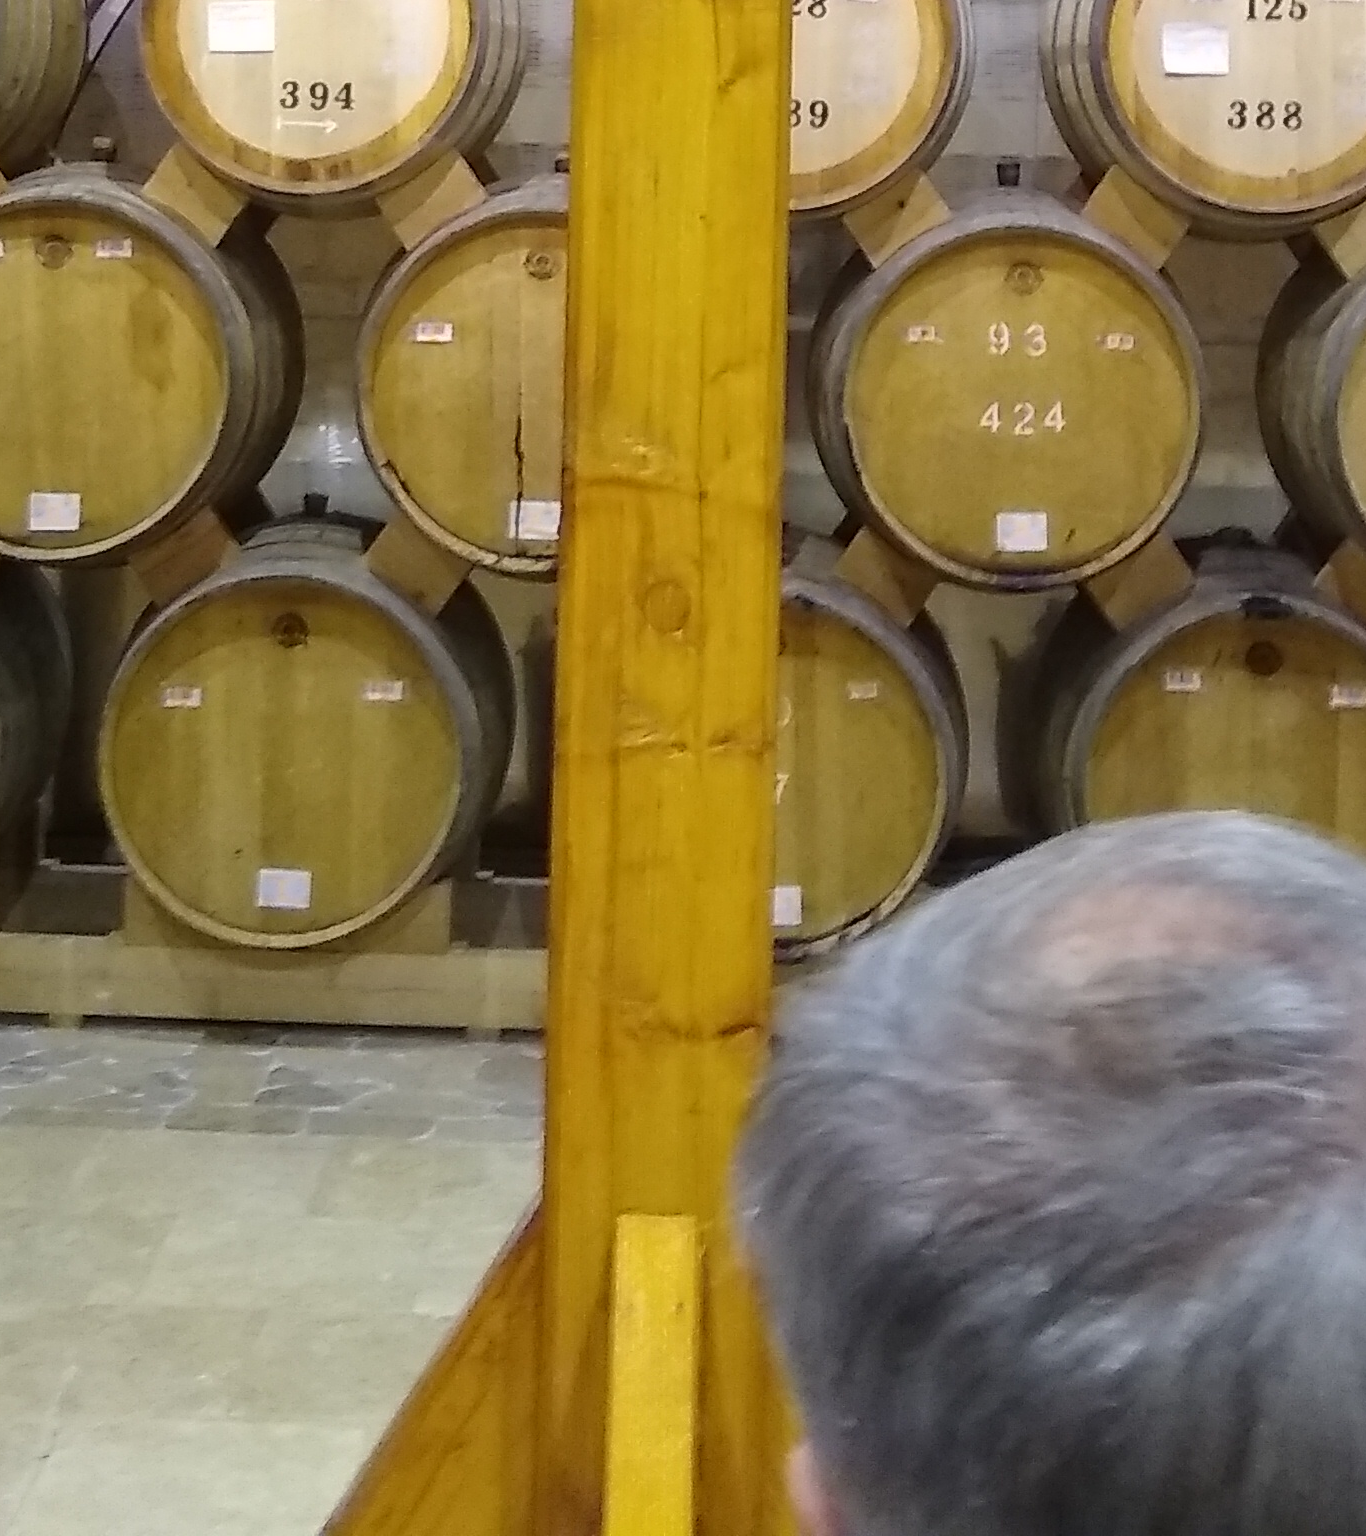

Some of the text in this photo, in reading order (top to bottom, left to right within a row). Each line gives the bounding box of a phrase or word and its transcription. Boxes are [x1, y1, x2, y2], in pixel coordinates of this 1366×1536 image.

[280, 81, 355, 111] 394
[1227, 100, 1304, 131] 388
[988, 321, 1048, 357] 93
[979, 401, 1066, 435] 424
